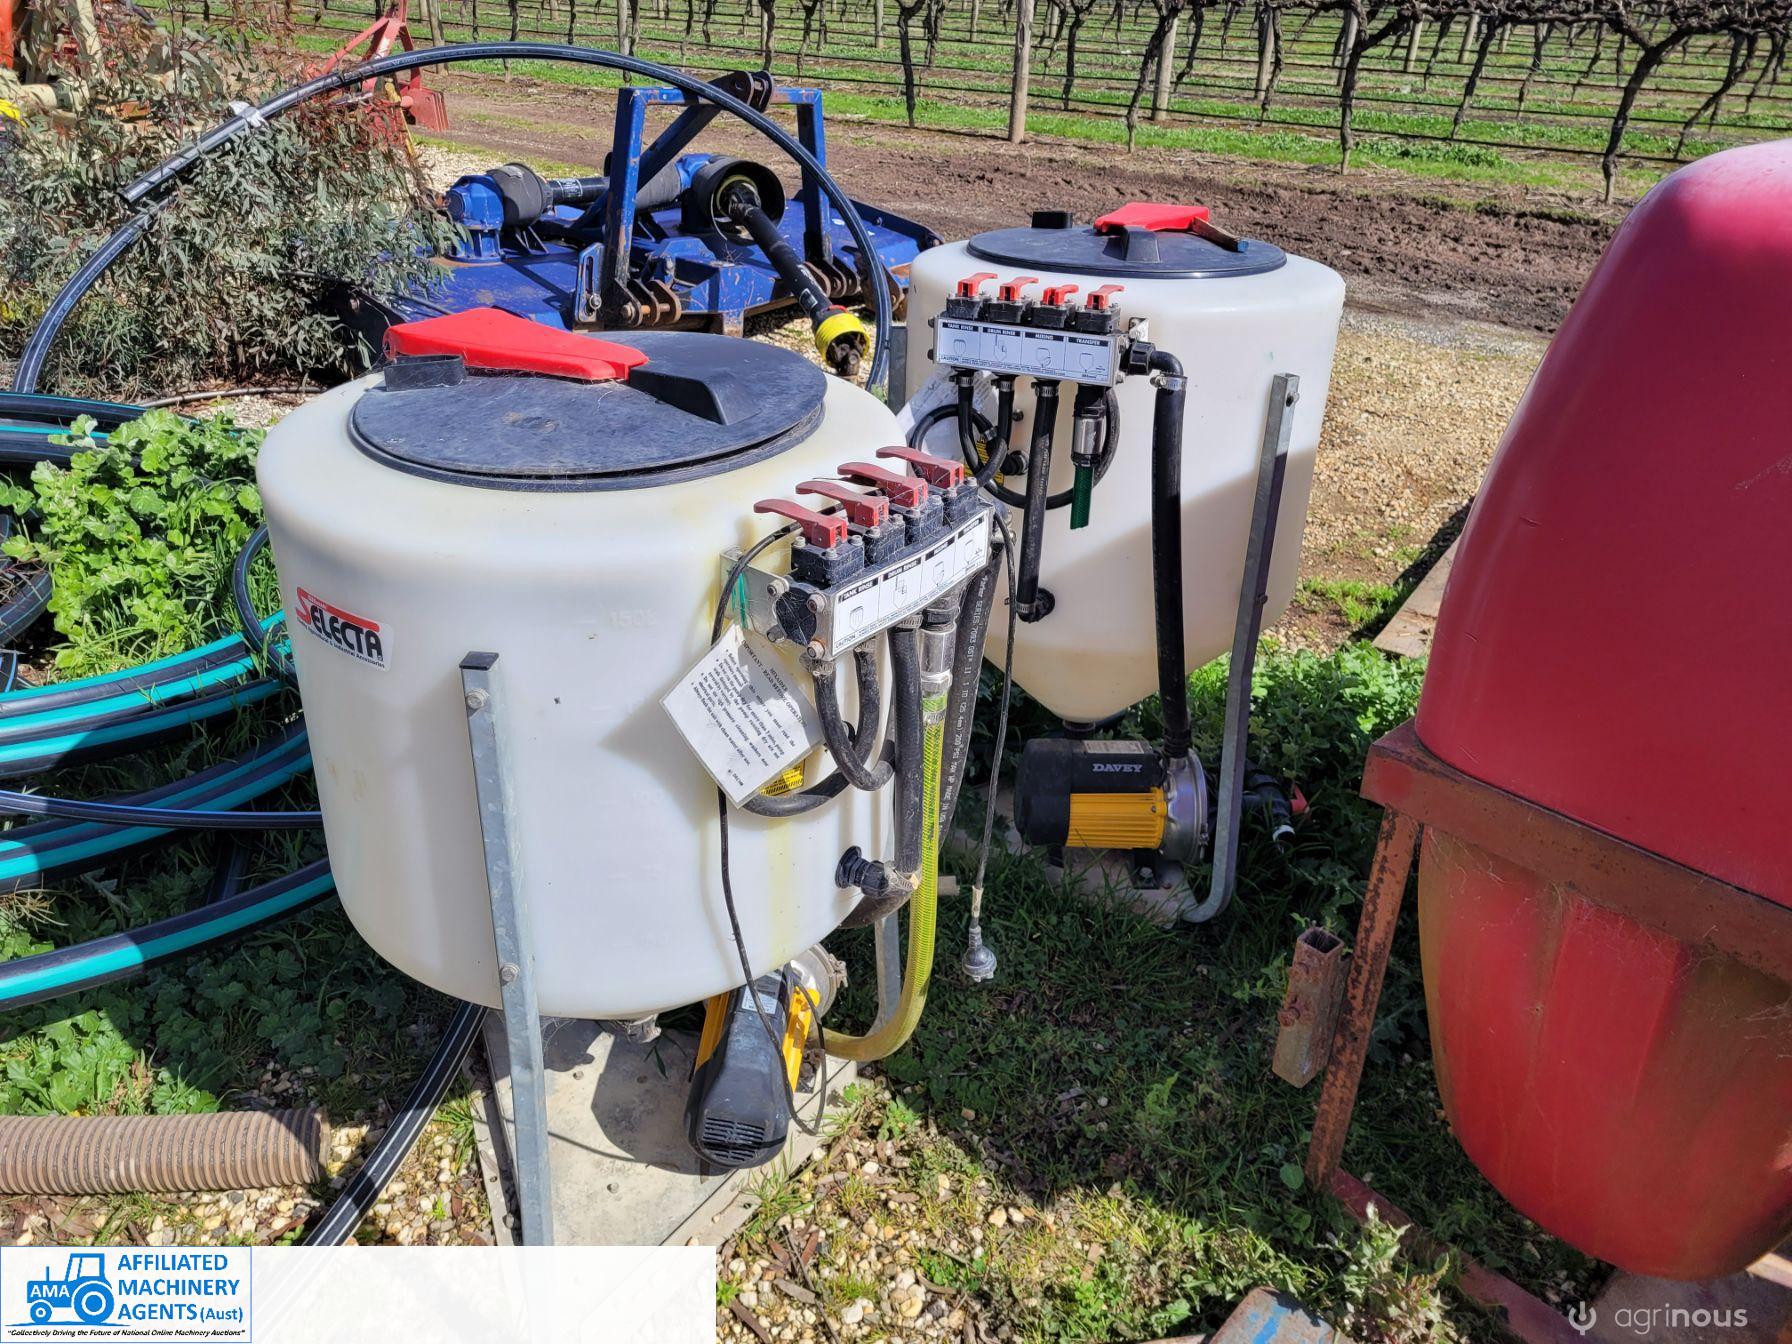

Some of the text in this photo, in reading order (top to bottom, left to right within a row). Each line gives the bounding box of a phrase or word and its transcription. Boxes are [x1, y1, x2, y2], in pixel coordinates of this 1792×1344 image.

[972, 600, 982, 624] SERIES
[296, 586, 384, 658] SELECTA
[762, 669, 774, 684] READ
[1092, 764, 1142, 772] DAVEY
